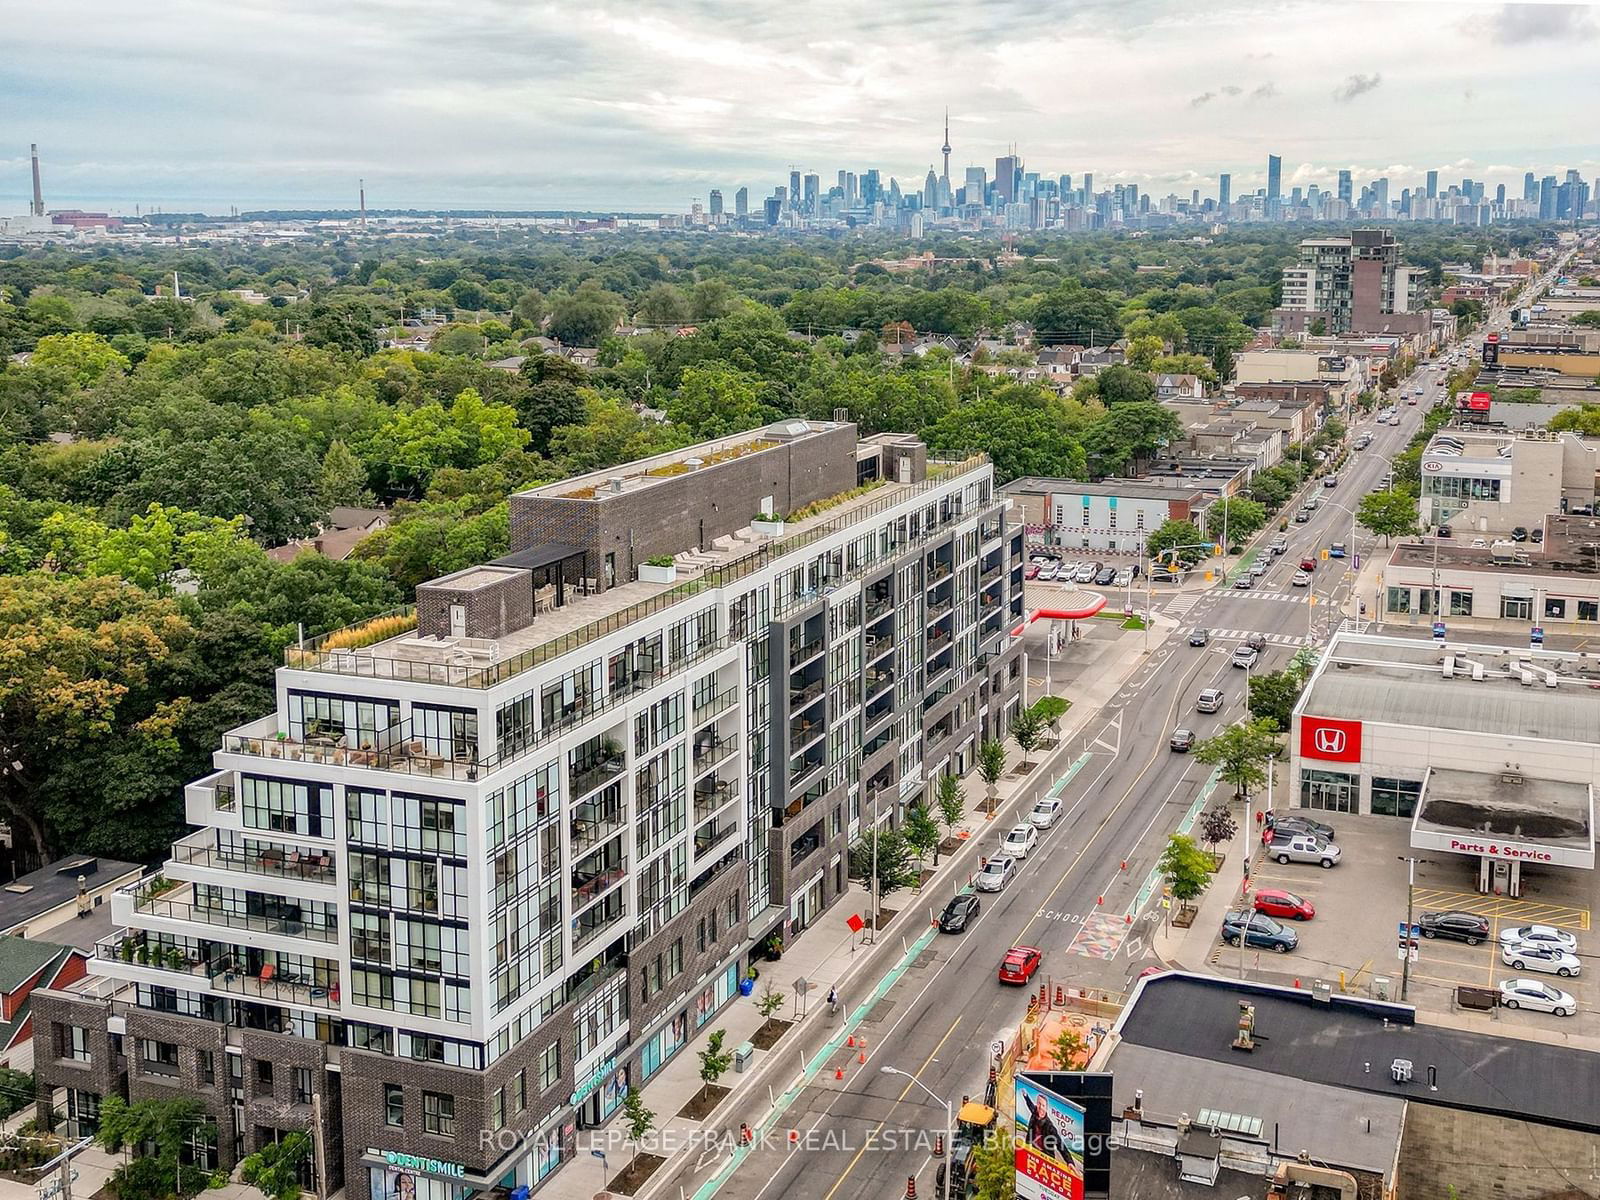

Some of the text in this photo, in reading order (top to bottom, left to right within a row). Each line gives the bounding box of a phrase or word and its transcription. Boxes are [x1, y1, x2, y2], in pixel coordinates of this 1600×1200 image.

[1450, 840, 1553, 861] Parts & Service
[1037, 909, 1087, 925] SCHOOL
[1051, 1108, 1075, 1125] READY
[1057, 1118, 1067, 1129] TO
[396, 1152, 465, 1178] DENTISMILE
[1026, 1159, 1072, 1192] RACE
[1026, 1168, 1072, 1198] CANADA
